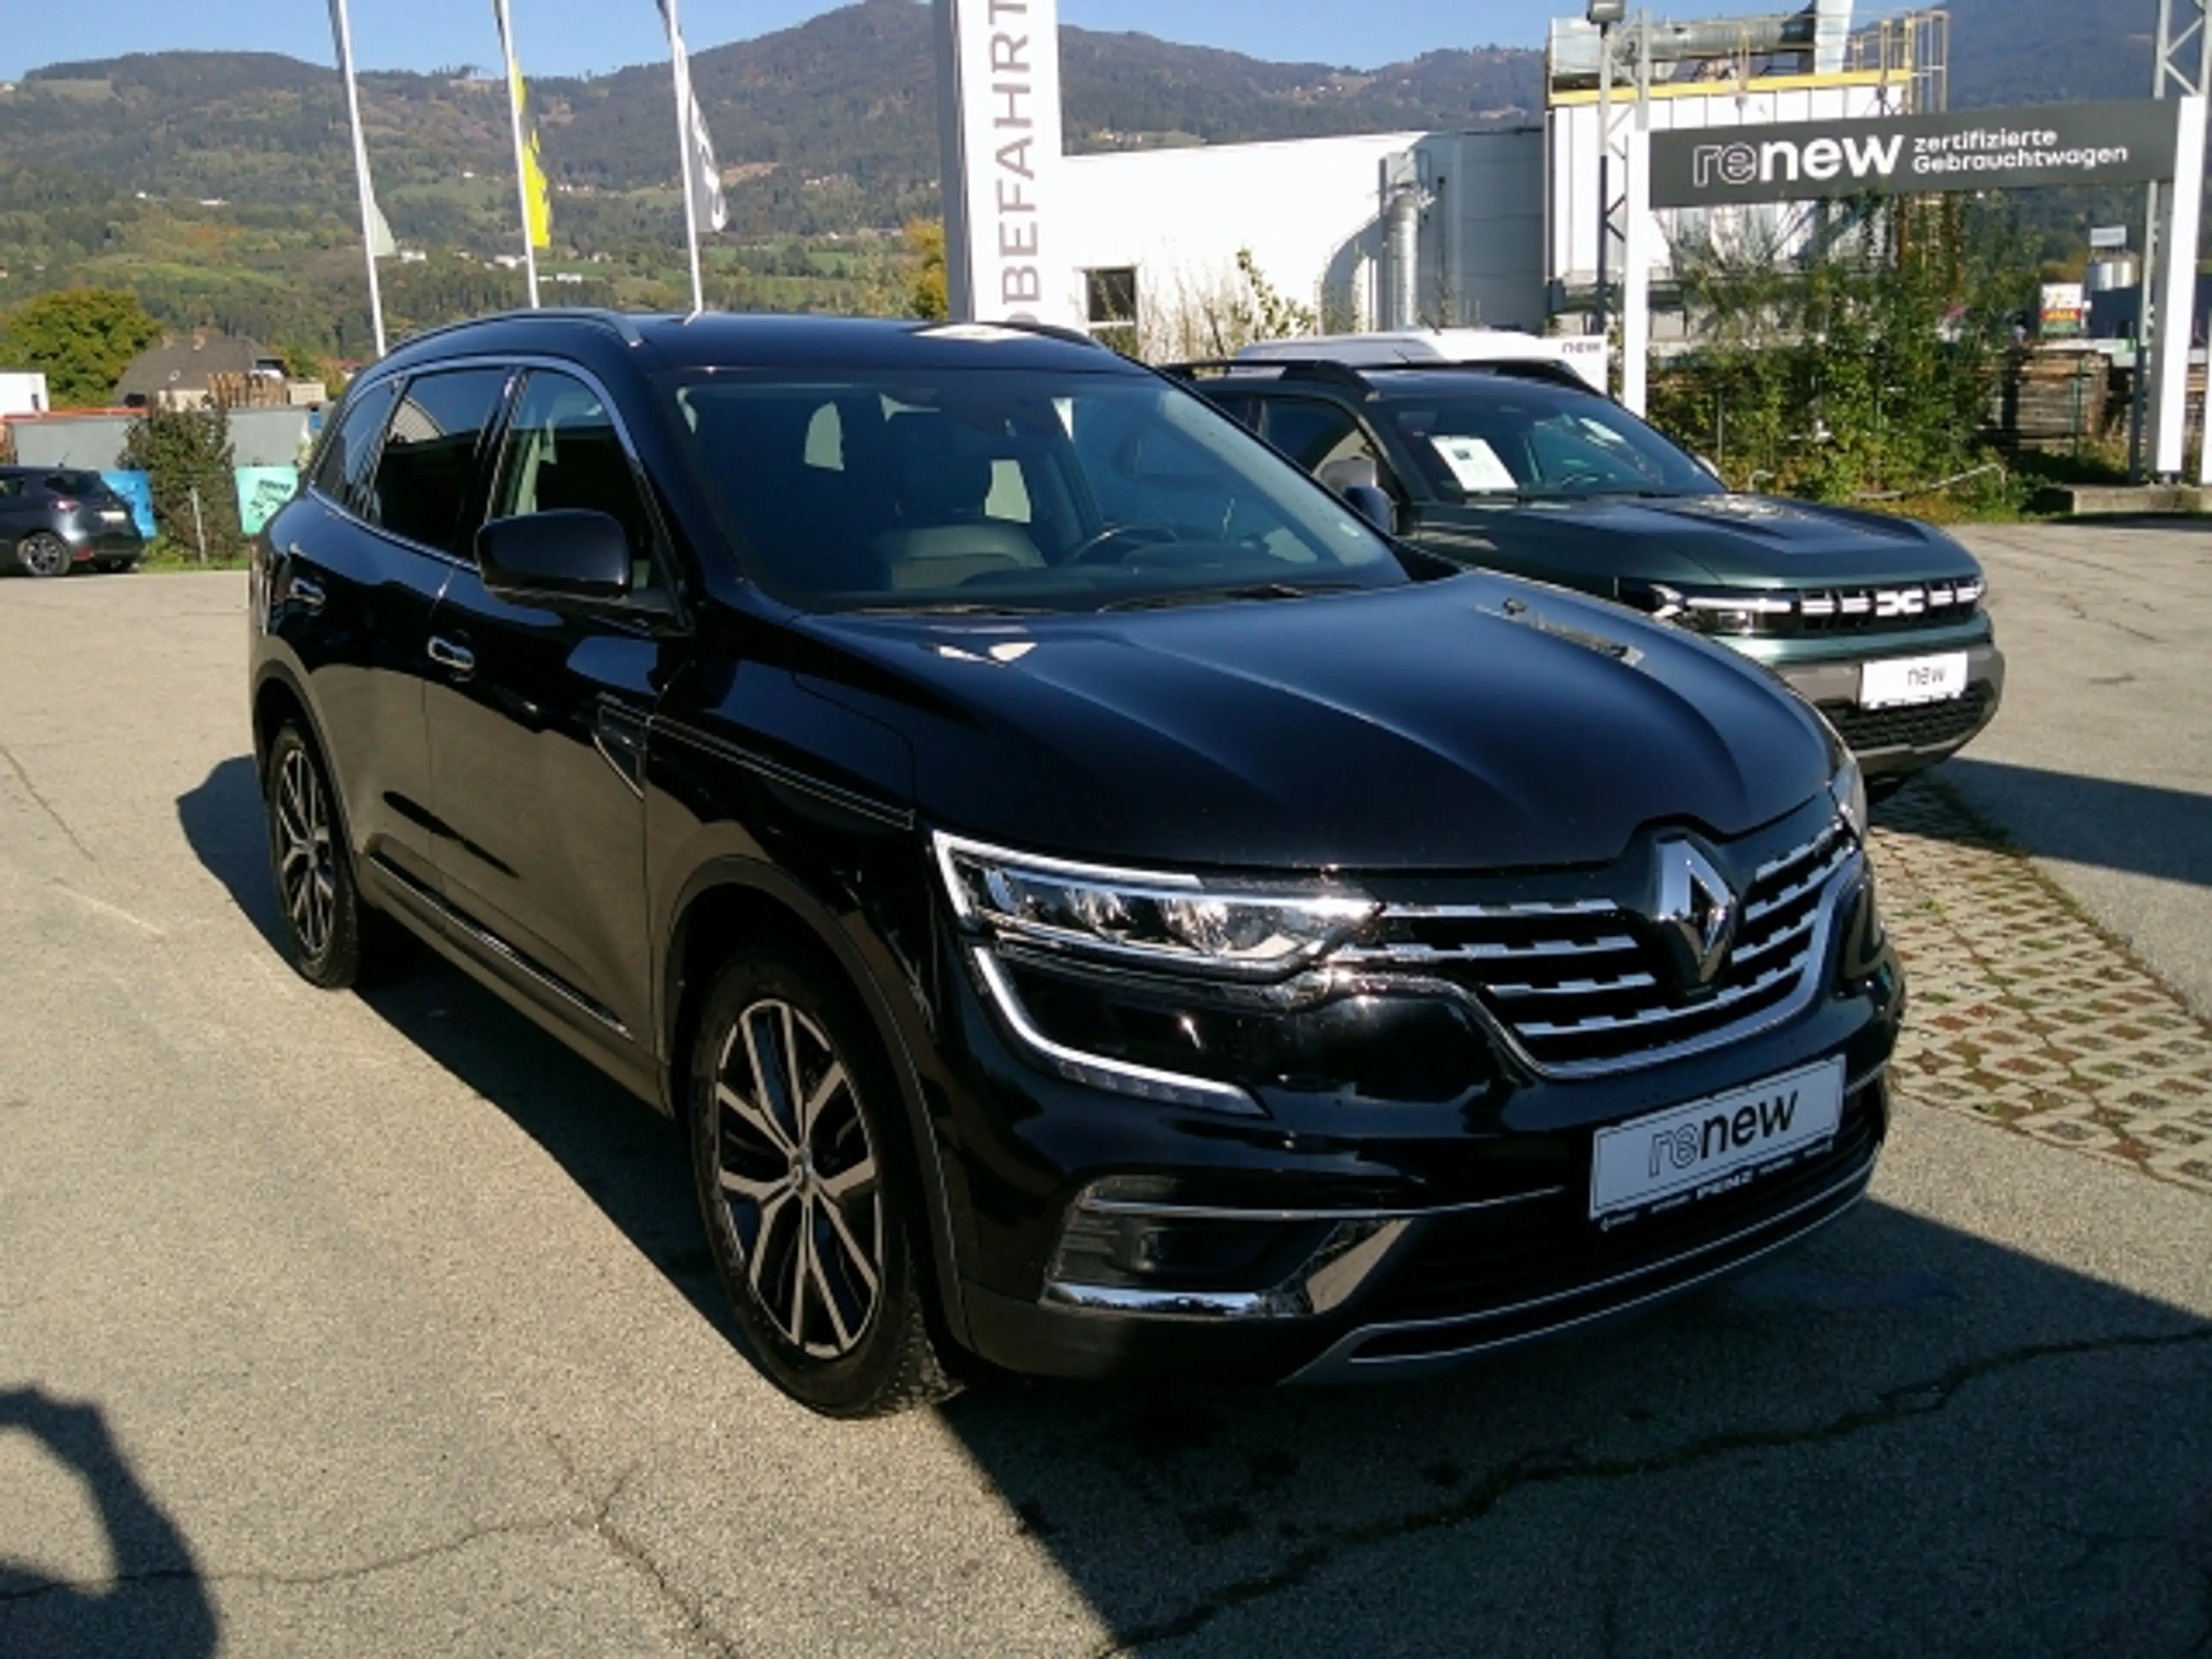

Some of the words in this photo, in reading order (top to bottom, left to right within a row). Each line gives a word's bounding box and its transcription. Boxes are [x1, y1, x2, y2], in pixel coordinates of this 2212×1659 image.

[1911, 146, 2128, 173] Gebrauchtwagen
[1913, 128, 2058, 153] zertifizierte
[1694, 135, 1903, 187] renew
[1649, 1090, 1799, 1178] renew
